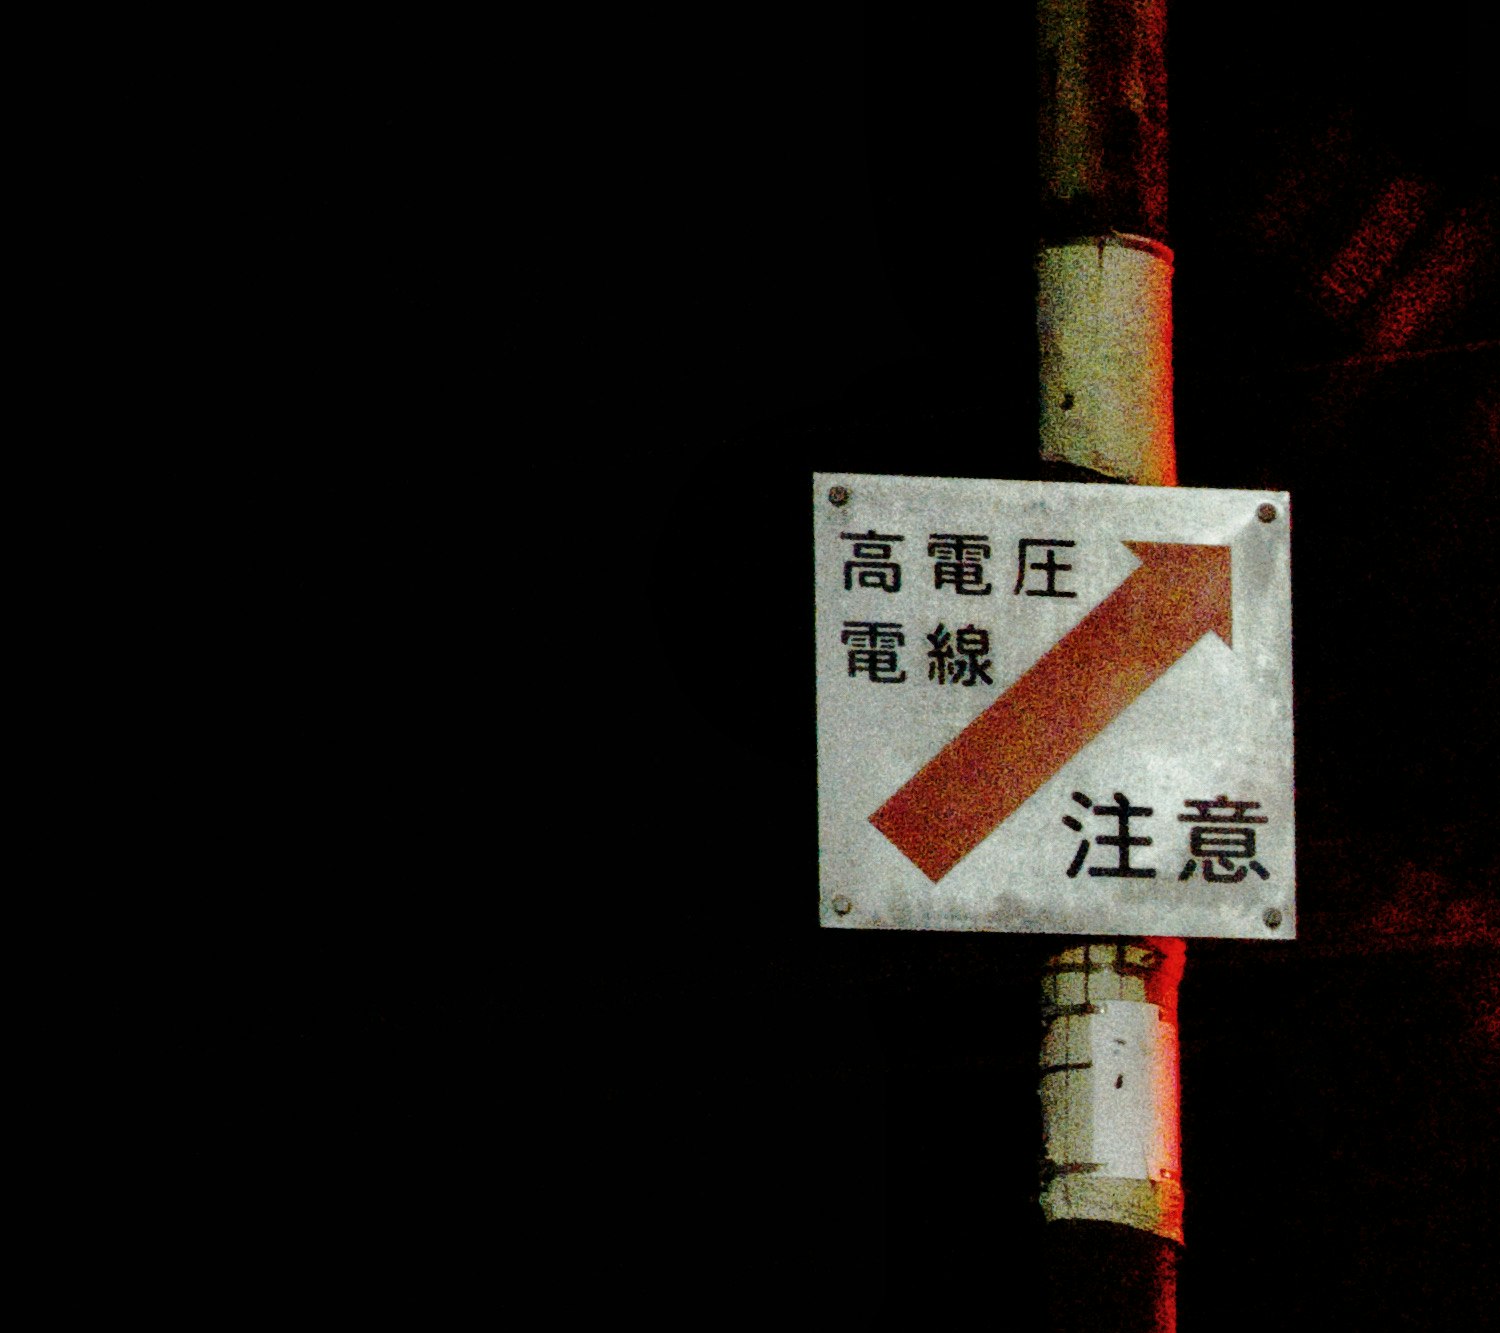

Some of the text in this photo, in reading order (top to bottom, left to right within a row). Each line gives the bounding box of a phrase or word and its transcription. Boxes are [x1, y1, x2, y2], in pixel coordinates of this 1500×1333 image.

[840, 530, 1078, 599] 高電圧
[840, 621, 994, 687] 電線
[1062, 792, 1270, 884] 注意
